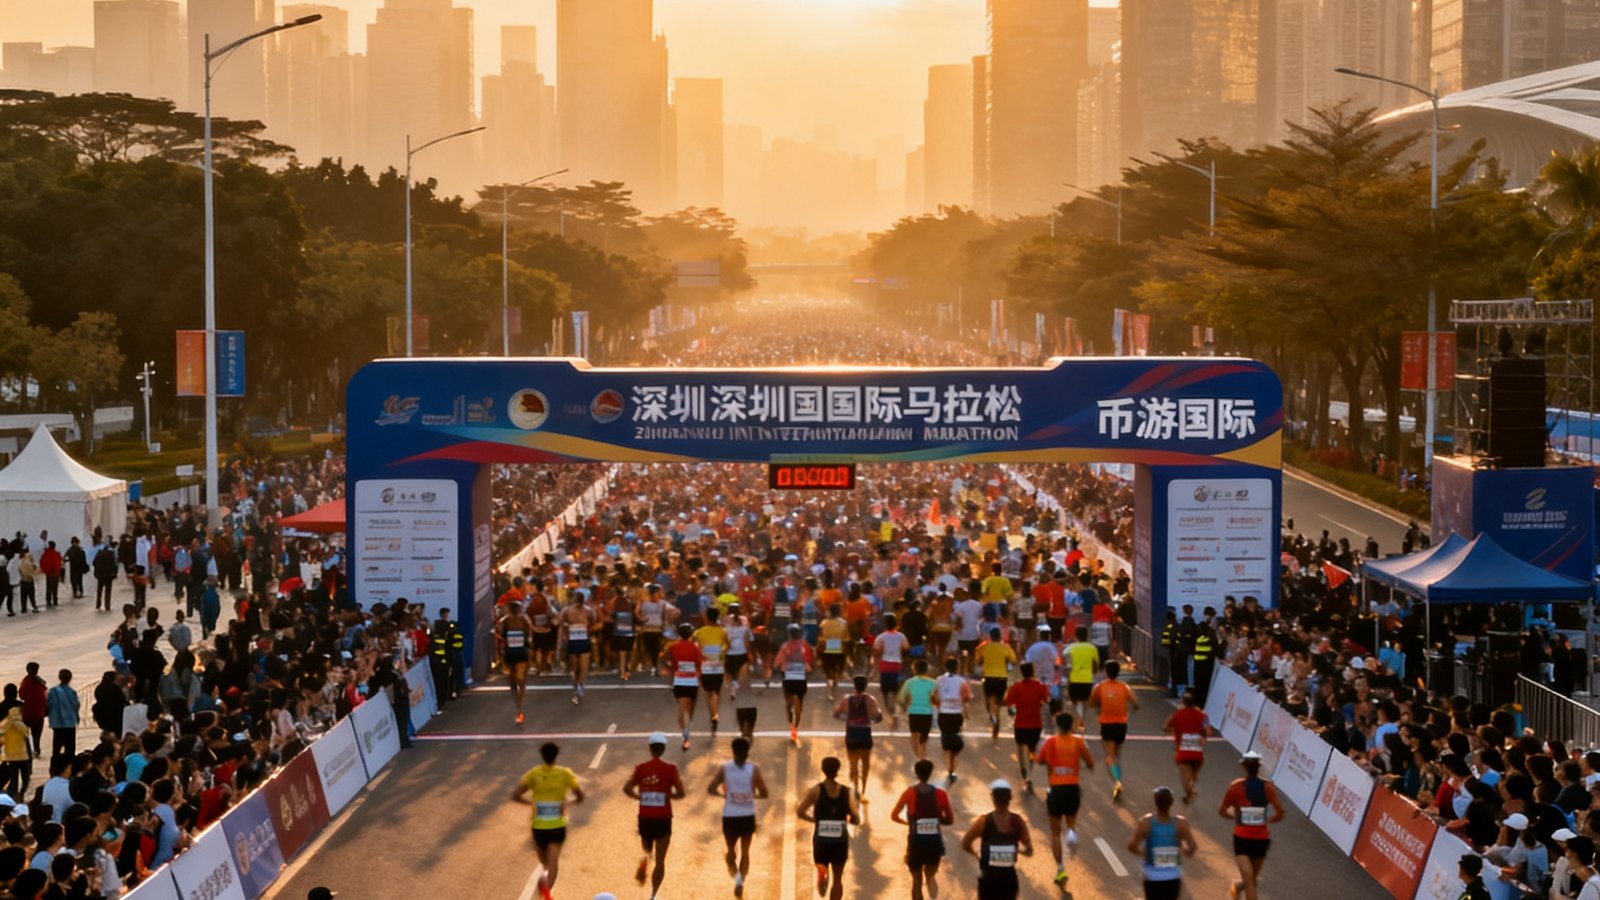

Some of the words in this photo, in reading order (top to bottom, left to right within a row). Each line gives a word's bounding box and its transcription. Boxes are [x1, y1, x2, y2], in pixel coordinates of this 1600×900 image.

[632, 384, 1021, 423] 深圳深圳国国际马拉松
[1097, 397, 1255, 440] 币游国际
